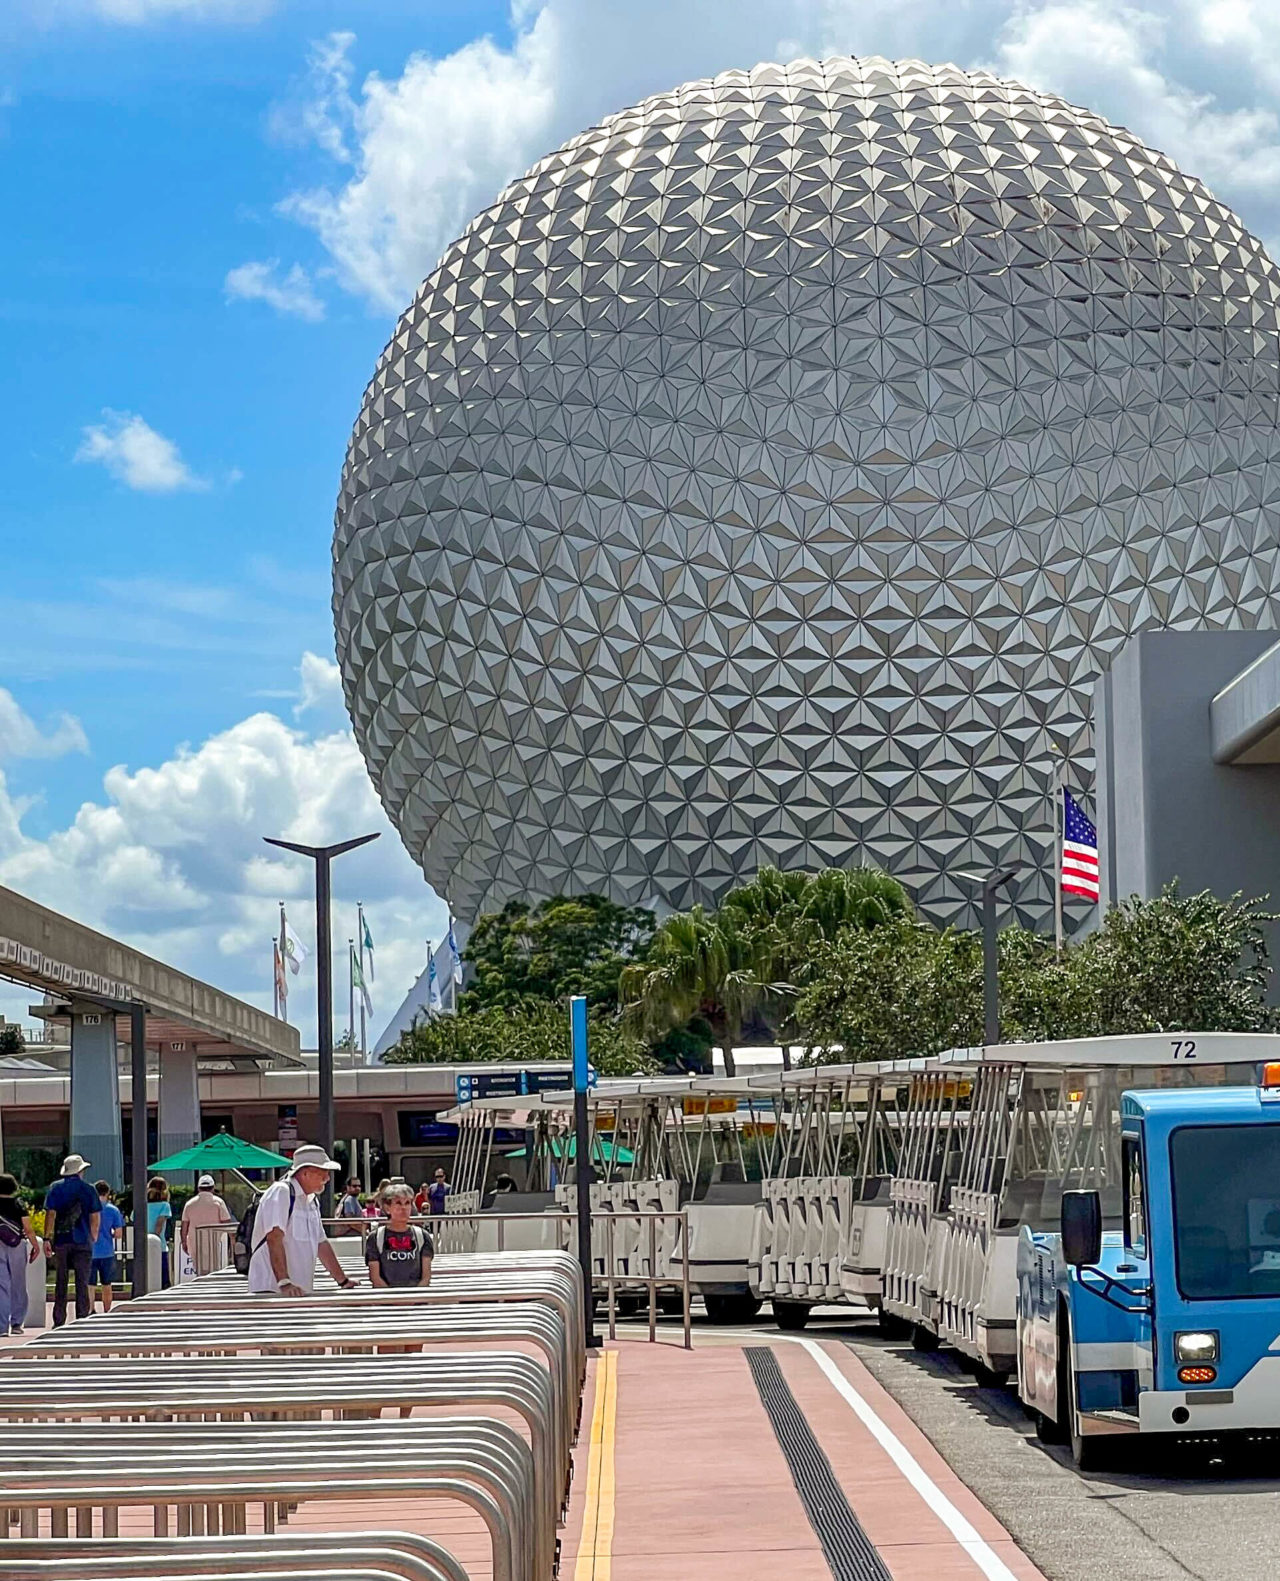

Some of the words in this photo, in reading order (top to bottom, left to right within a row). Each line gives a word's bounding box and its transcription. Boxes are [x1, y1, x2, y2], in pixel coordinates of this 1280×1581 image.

[85, 1015, 99, 1023] 176
[171, 1042, 184, 1050] 177
[1171, 1040, 1196, 1059] 72
[387, 1251, 416, 1260] ICON
